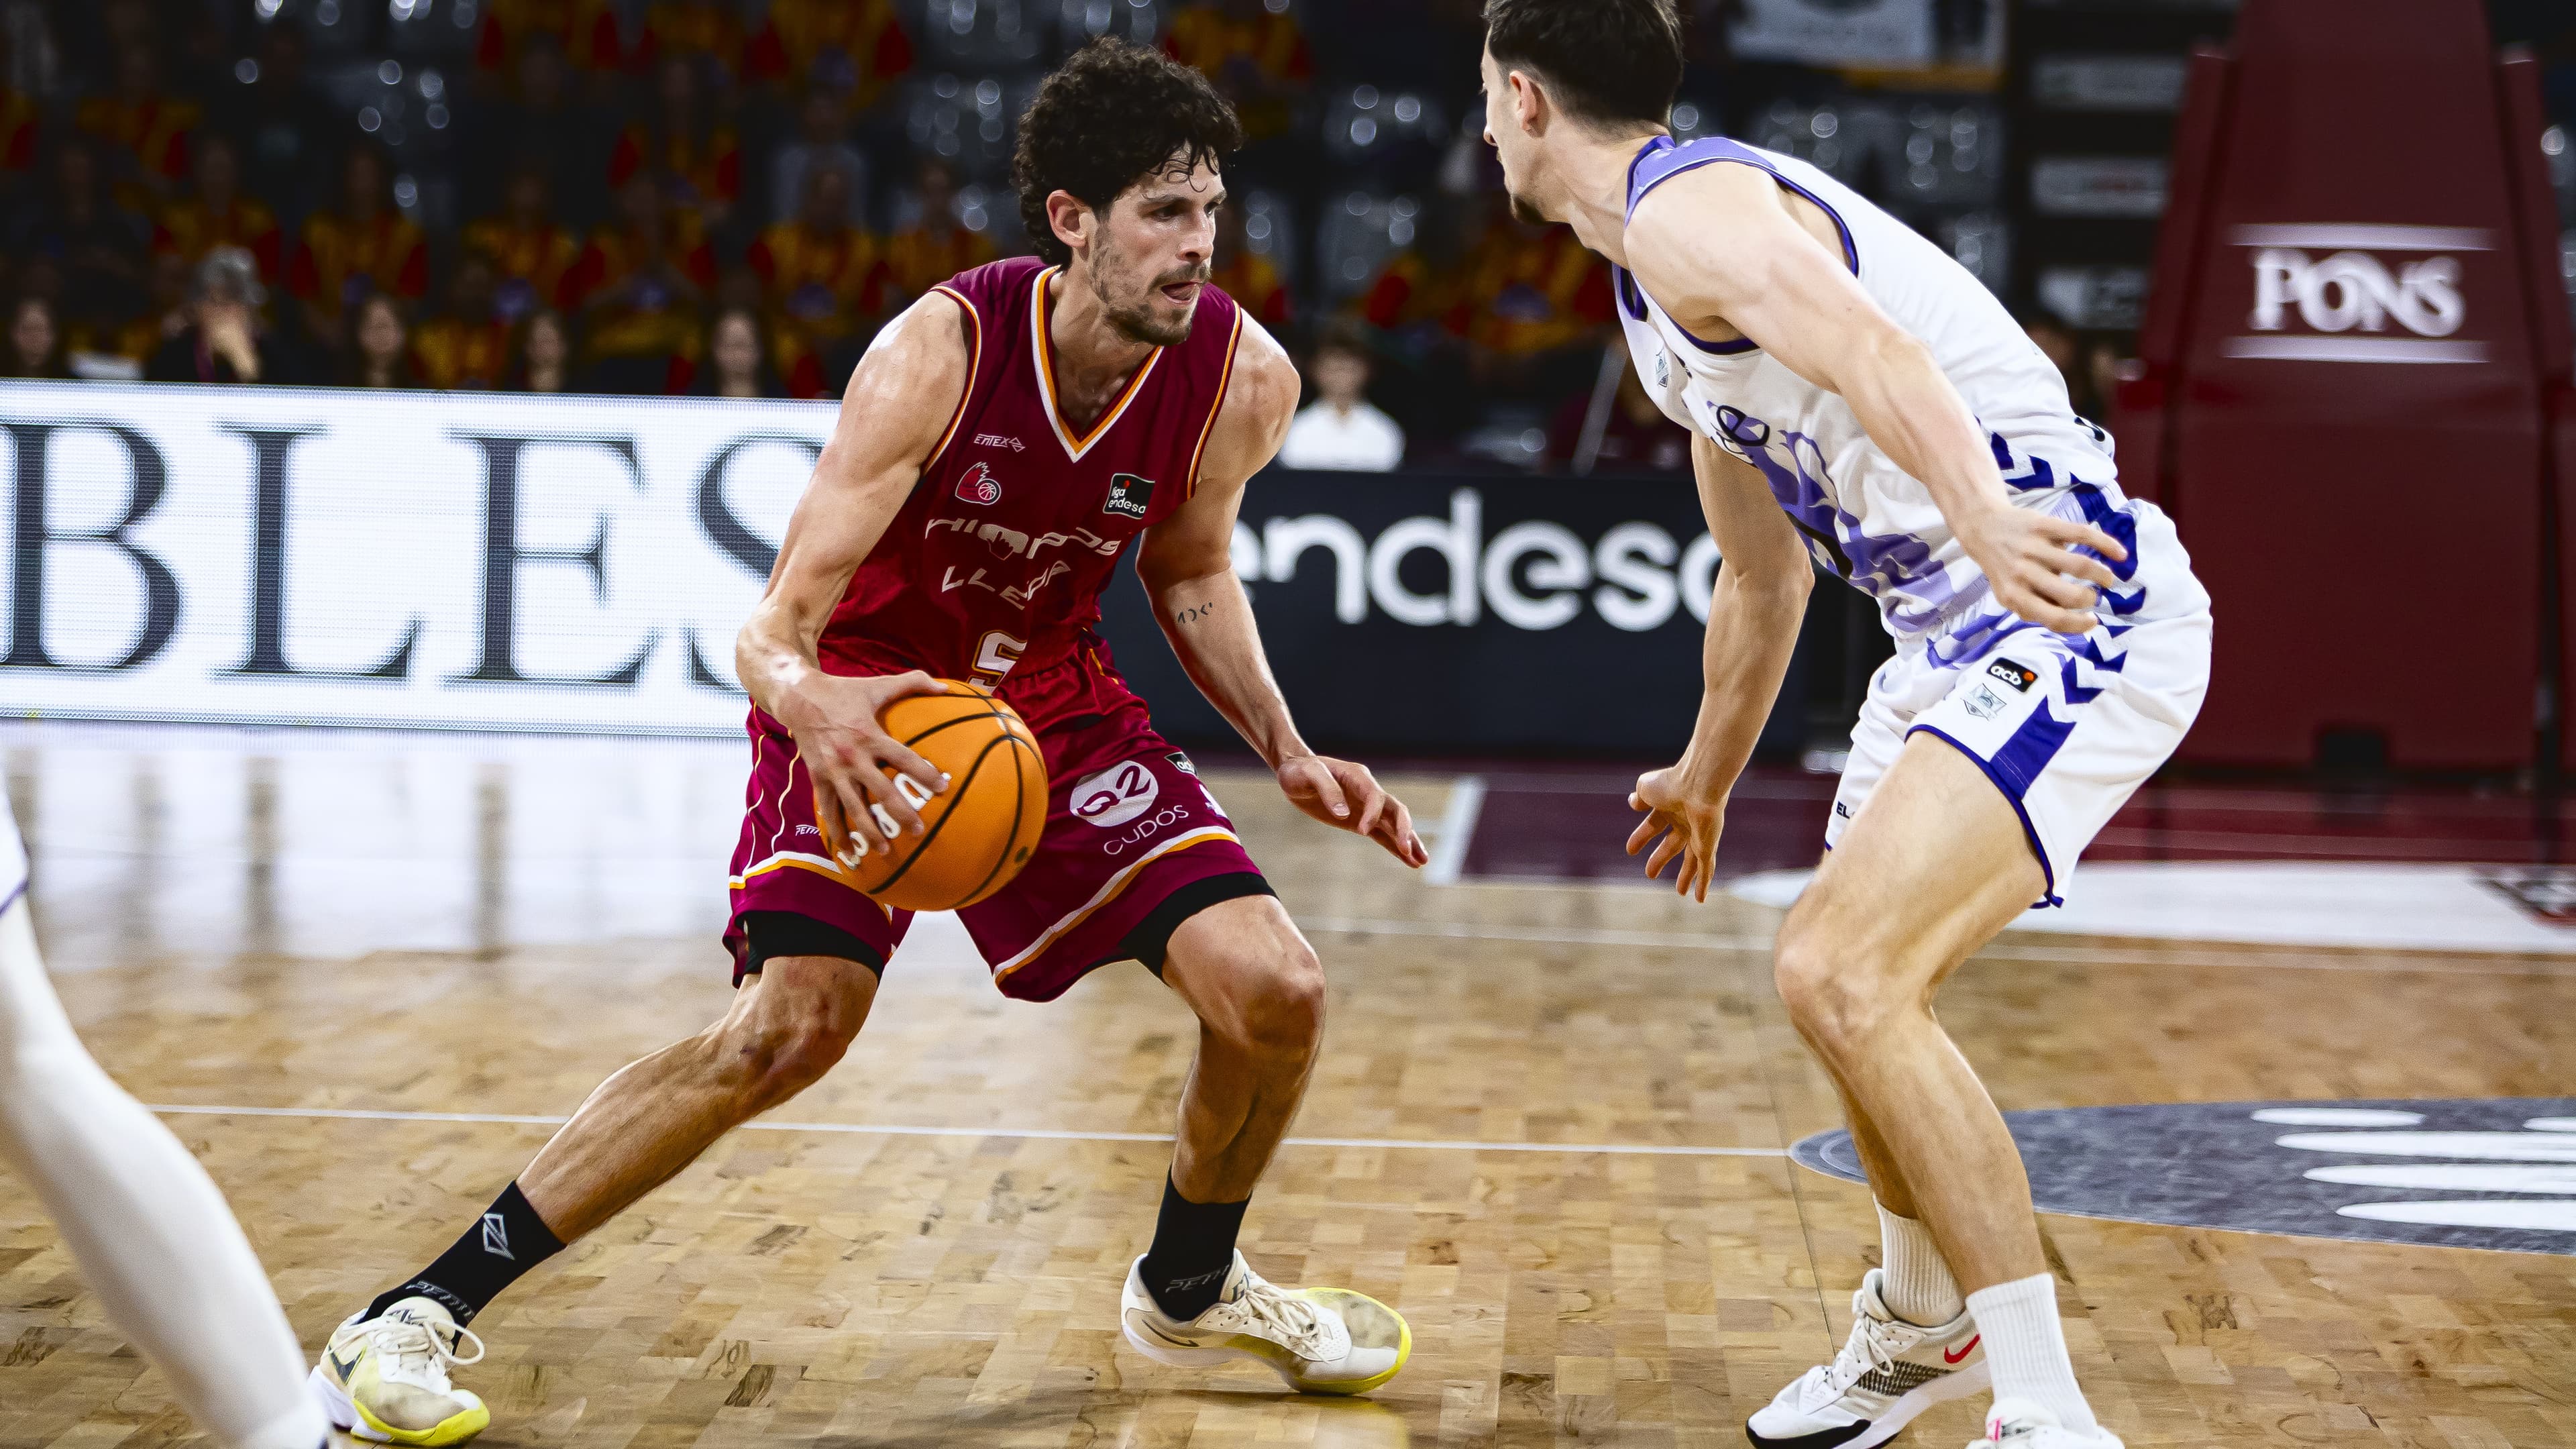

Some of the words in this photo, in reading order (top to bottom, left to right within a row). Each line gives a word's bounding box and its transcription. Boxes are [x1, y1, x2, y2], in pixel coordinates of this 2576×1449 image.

[2249, 248, 2466, 337] PONS
[1111, 486, 1126, 498] liga
[1108, 498, 1146, 514] endesa
[1990, 665, 2022, 686] acb
[1103, 805, 1189, 855] CUDÓS
